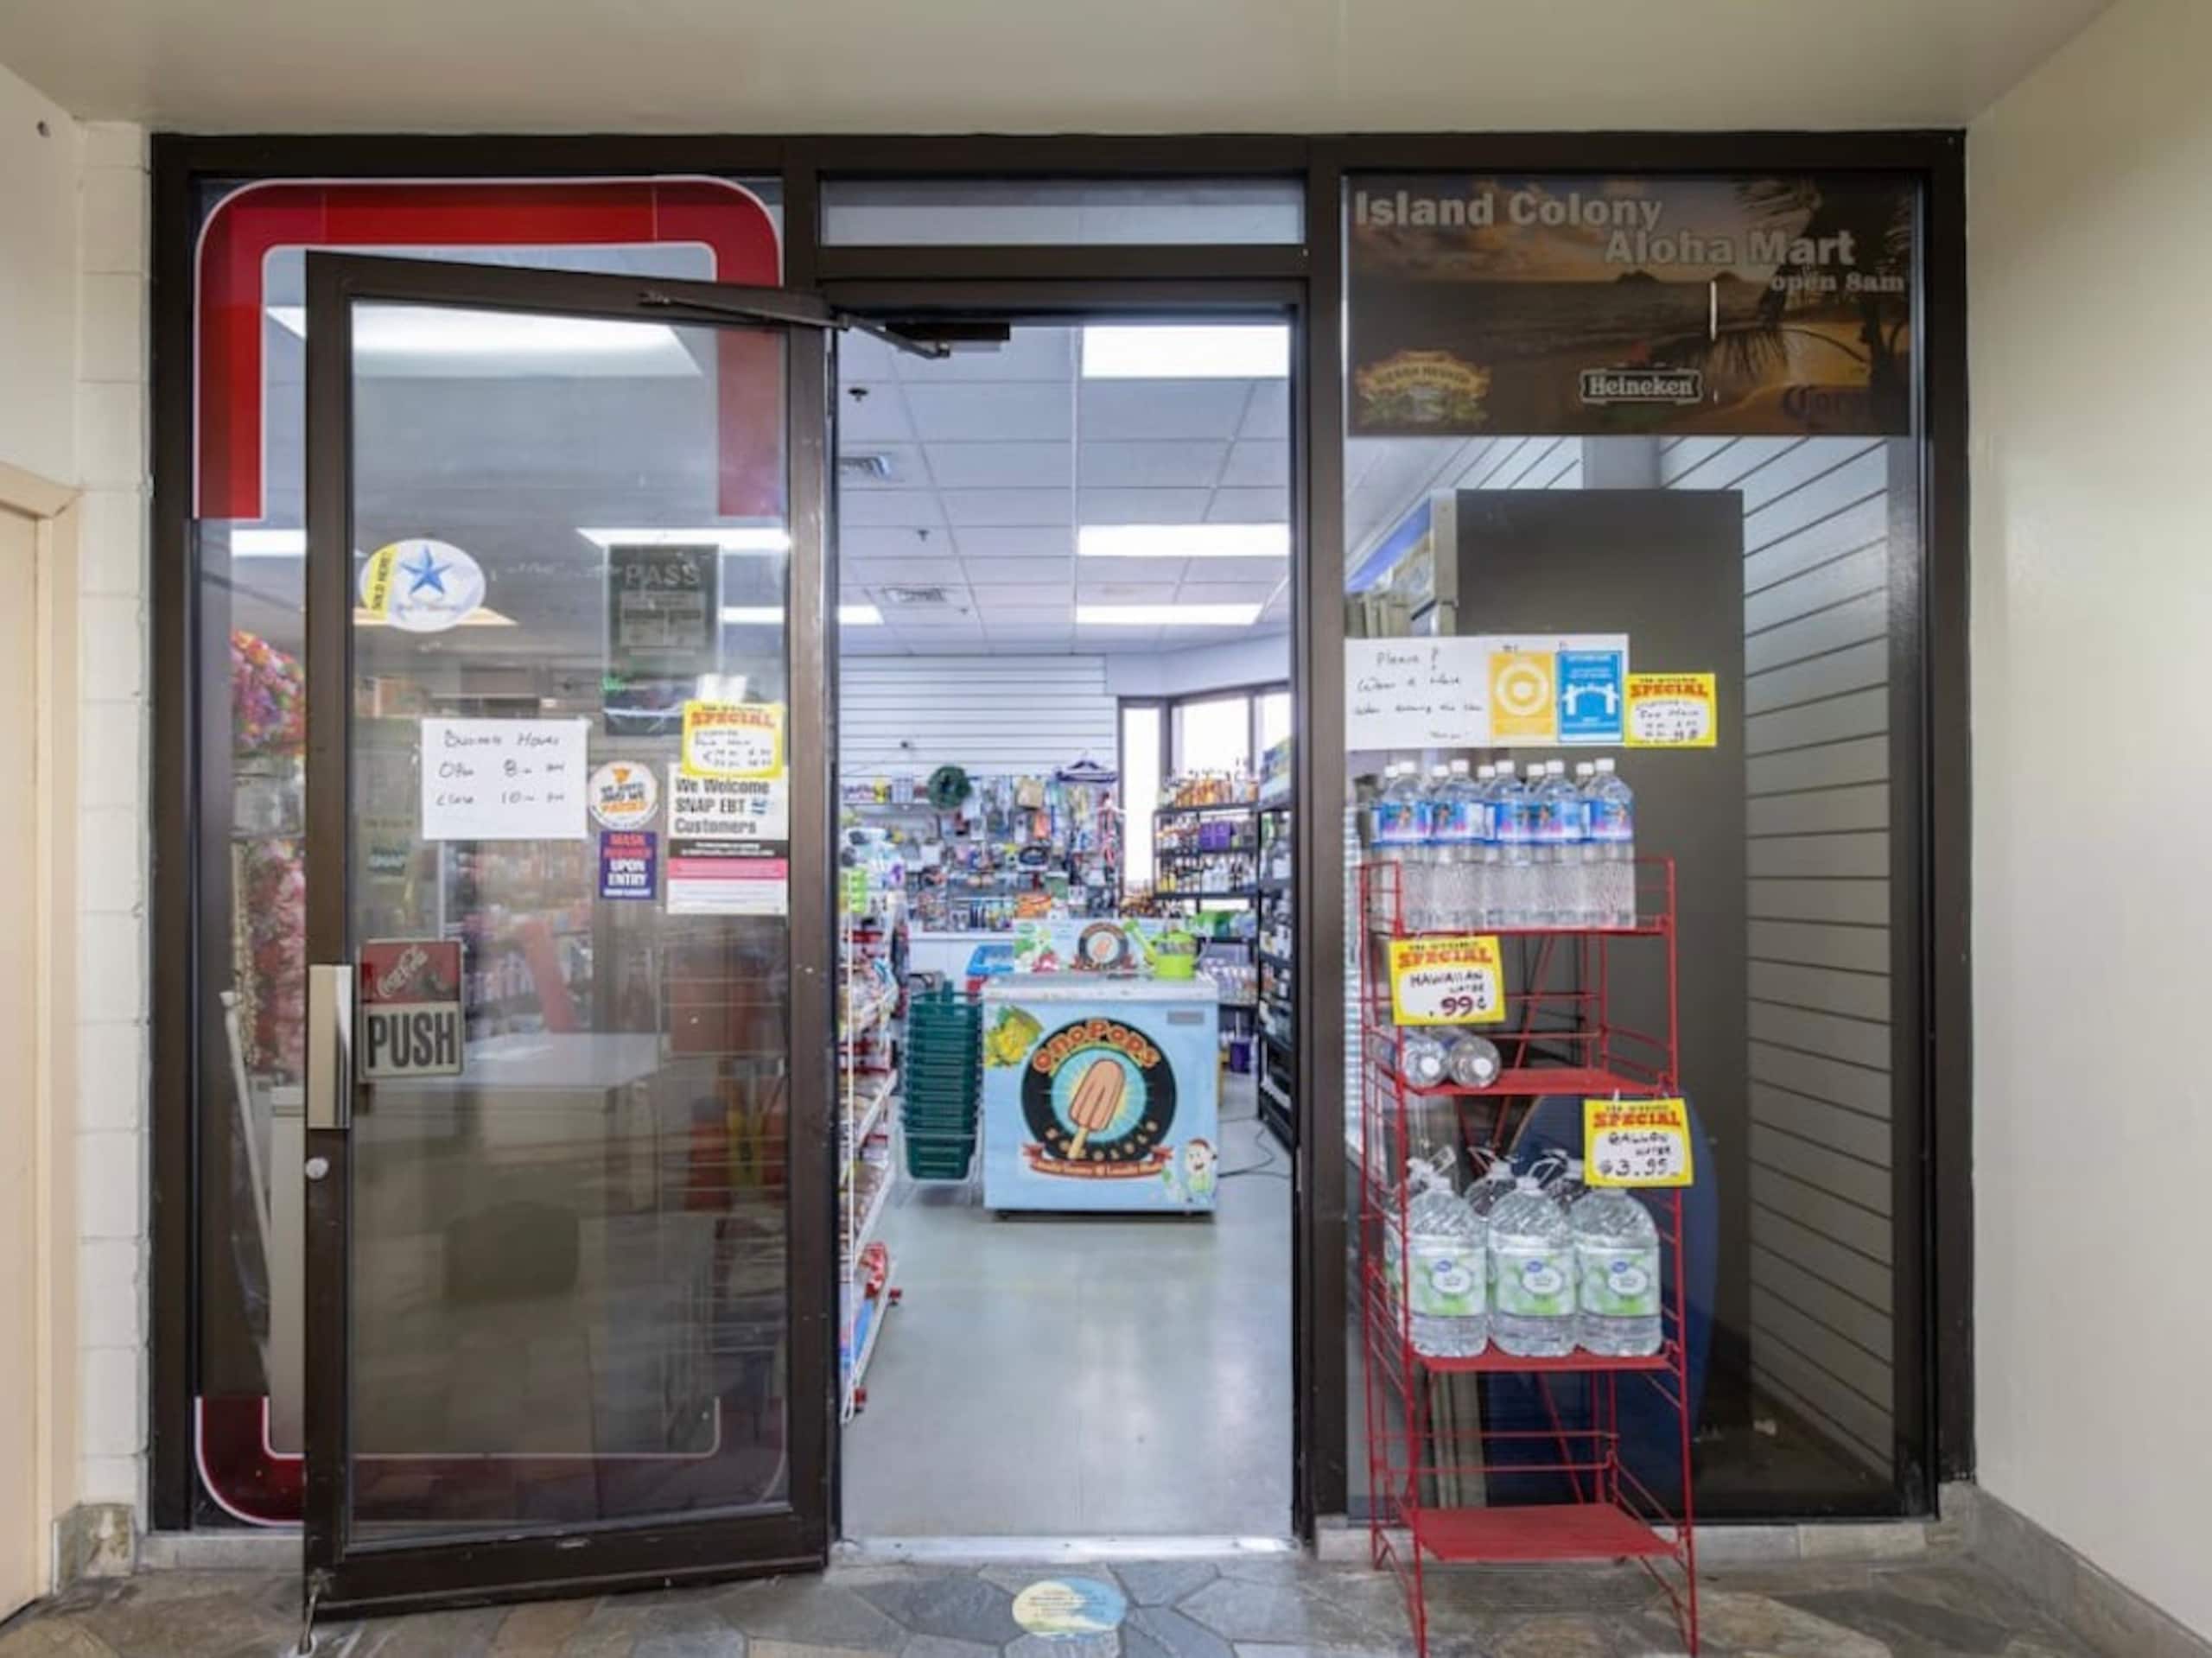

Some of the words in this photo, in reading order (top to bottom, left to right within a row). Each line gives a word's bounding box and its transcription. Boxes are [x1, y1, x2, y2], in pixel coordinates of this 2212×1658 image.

[1355, 191, 1494, 227] Island
[1509, 192, 1662, 232] Colony
[1605, 230, 1735, 265] Aloha
[1749, 230, 1855, 265] Mart
[1771, 274, 1836, 295] open
[1846, 273, 1904, 292] 8am
[1589, 375, 1694, 396] Heineken
[625, 563, 701, 586] PASS
[1630, 683, 1708, 698] SPECIAL
[691, 711, 775, 729] SPECIAL
[676, 778, 698, 793] We
[703, 778, 770, 794] Welcome
[676, 797, 715, 813] SNAP
[721, 798, 746, 813] EBT
[675, 818, 757, 834] Customers
[610, 860, 645, 873] UPON
[607, 873, 647, 886] ENTRY
[1399, 948, 1493, 969] SPECIAL
[368, 1012, 455, 1069] PUSH
[1593, 1111, 1681, 1128] SPECIAL
